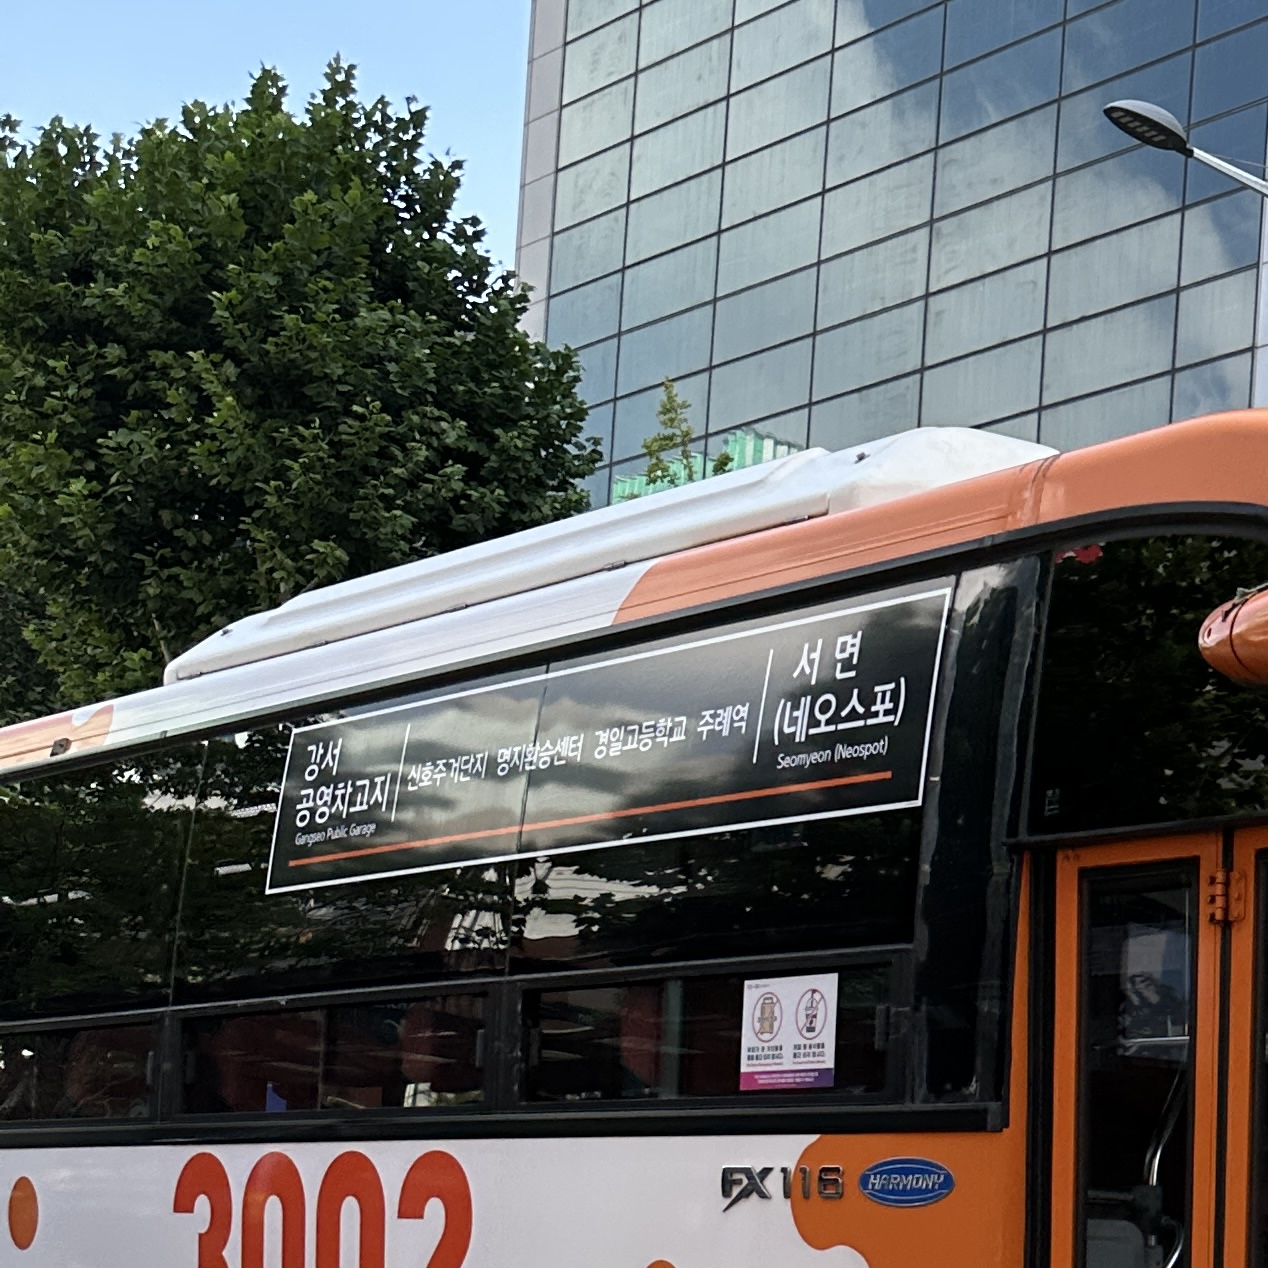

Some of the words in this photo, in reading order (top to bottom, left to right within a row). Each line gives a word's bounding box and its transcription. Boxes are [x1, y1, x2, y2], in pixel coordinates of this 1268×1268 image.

[792, 630, 862, 685] 서면
[773, 677, 906, 745] (네오스포)
[304, 738, 342, 781] 강서
[407, 751, 488, 791] 신호주거단지
[497, 733, 584, 776] 명지환승센터
[594, 716, 687, 759] 경일고등학교
[697, 702, 750, 741] 주례역
[776, 750, 832, 769] Seomyeon
[834, 735, 889, 762] (Neospot)
[296, 773, 391, 827] 공영차고지
[295, 832, 326, 848] Gangseo
[326, 825, 348, 840] Public
[349, 823, 377, 837] Garage
[868, 1174, 945, 1190] HARMONY
